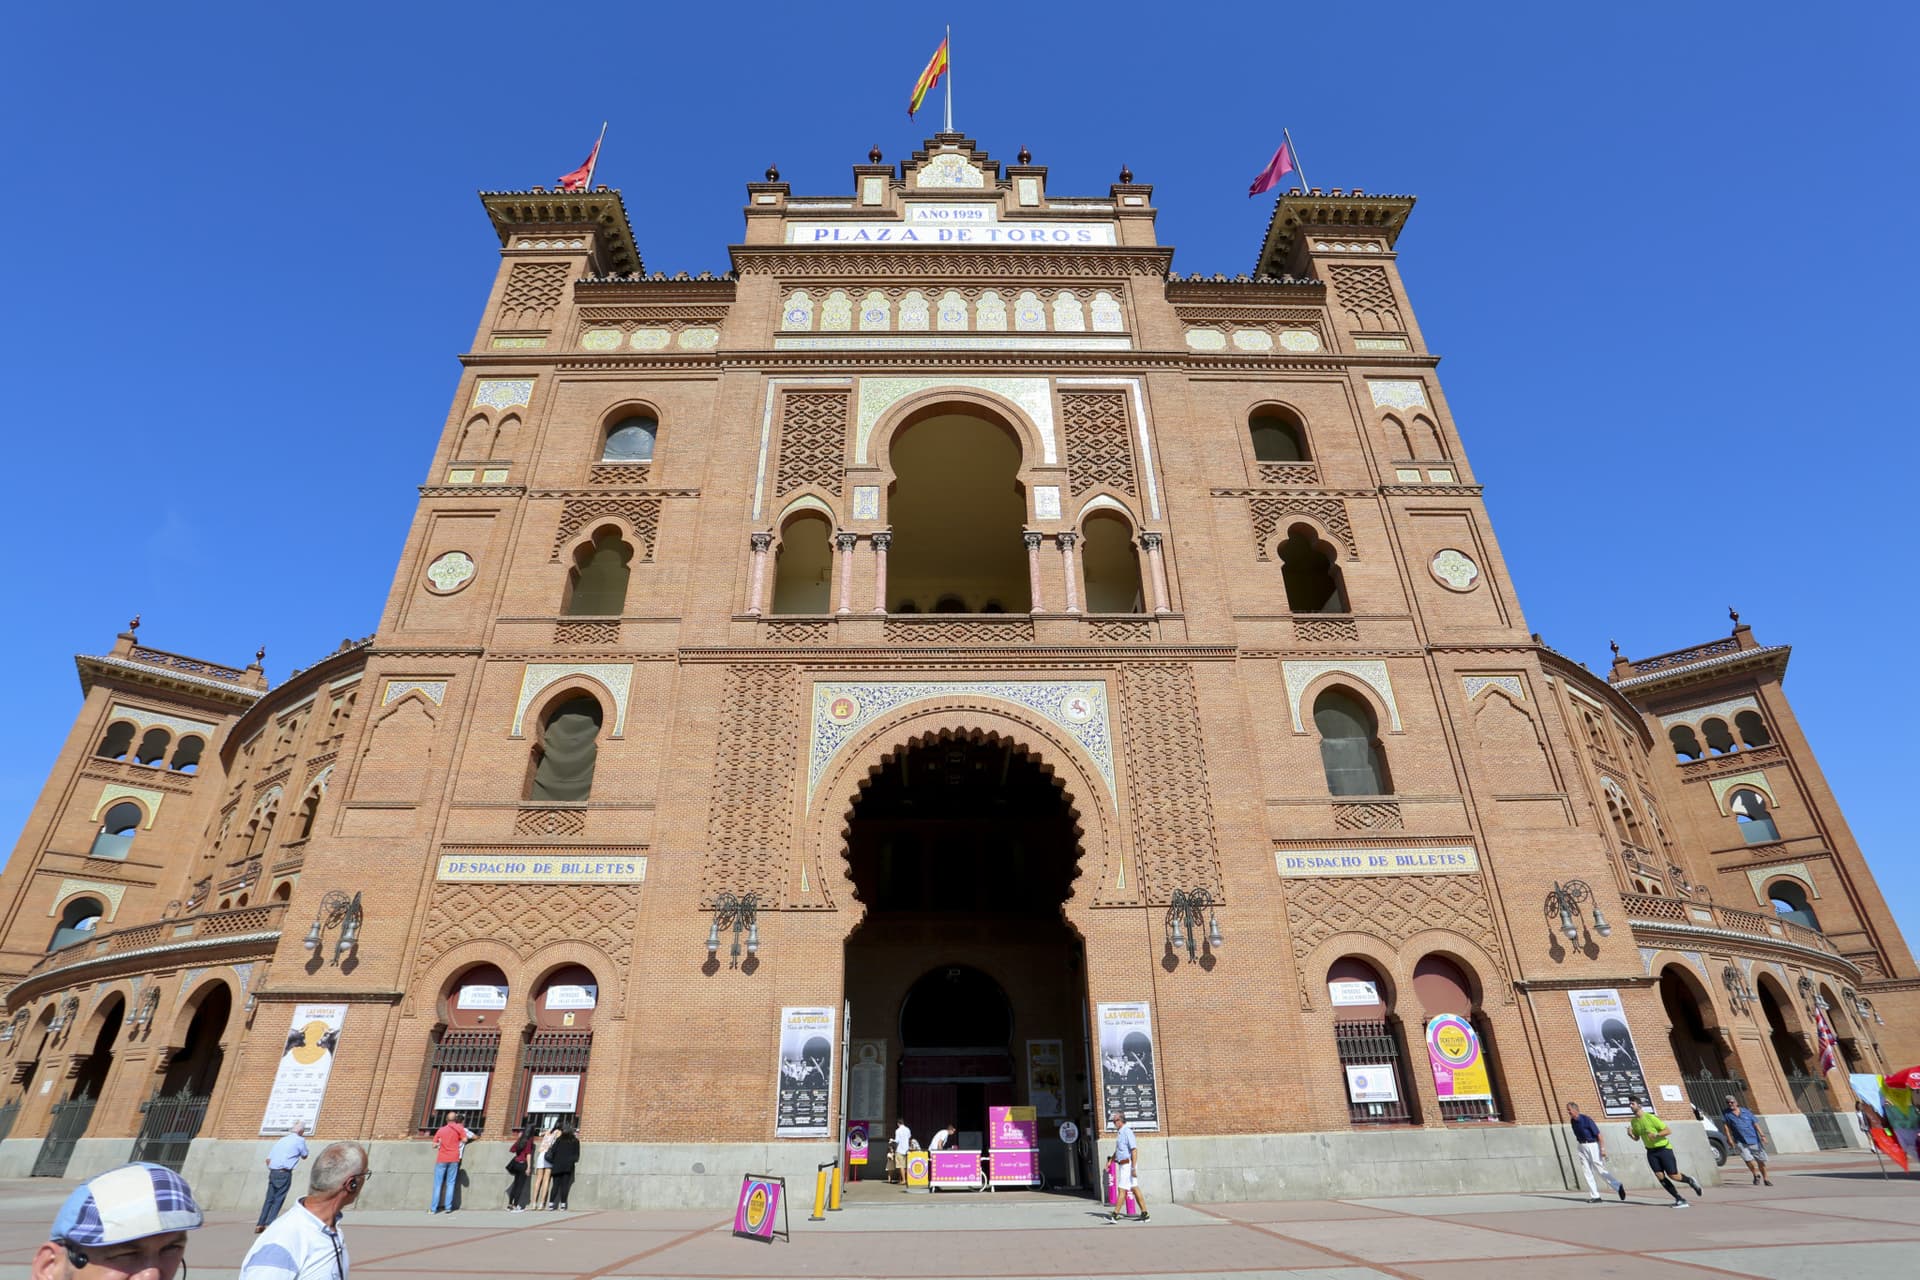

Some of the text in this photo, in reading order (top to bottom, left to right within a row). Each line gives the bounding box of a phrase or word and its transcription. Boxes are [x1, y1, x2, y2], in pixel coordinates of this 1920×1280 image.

[918, 209, 983, 219] AÑO 1929
[814, 228, 1092, 242] PLAZA DE TOROS
[1286, 854, 1467, 868] DESPACHO DE BILLETES
[448, 862, 636, 874] DESPACHO DE BILLETES
